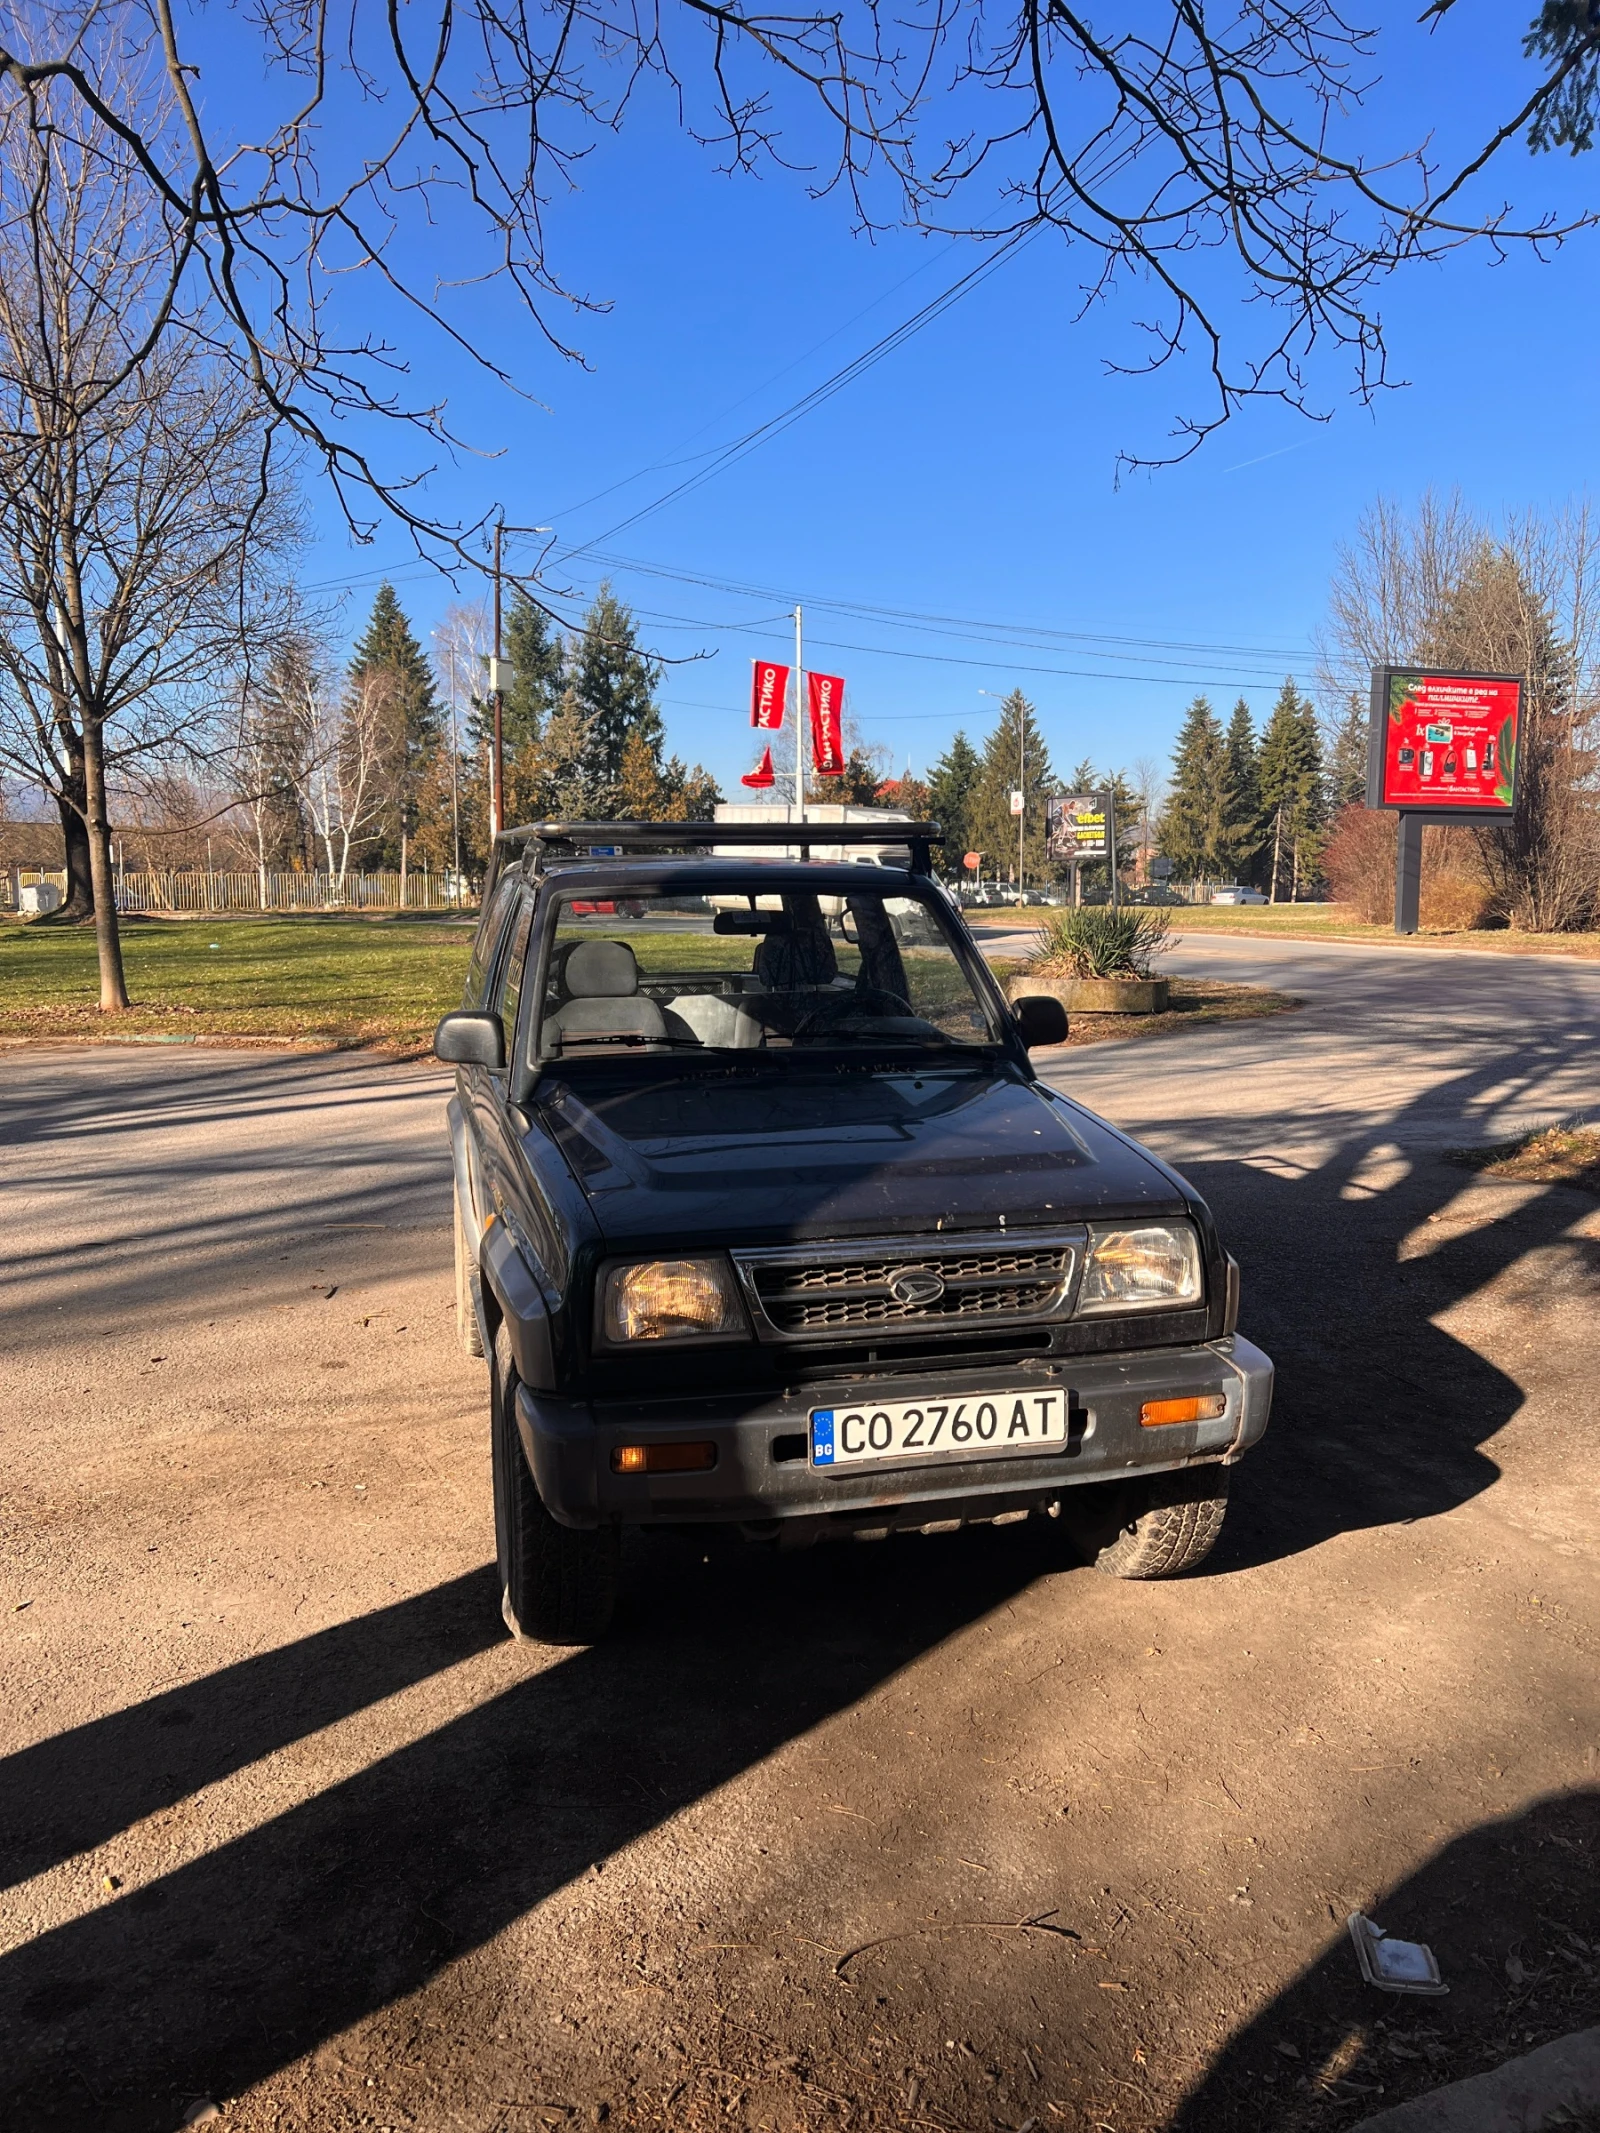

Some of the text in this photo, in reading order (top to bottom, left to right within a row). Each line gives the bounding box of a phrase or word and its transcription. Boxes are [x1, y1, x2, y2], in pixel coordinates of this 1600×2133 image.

[1408, 683, 1426, 694] След
[1077, 812, 1105, 824] efbet
[841, 1397, 1057, 1454] CO 2760 AT
[815, 1444, 833, 1458] BG
